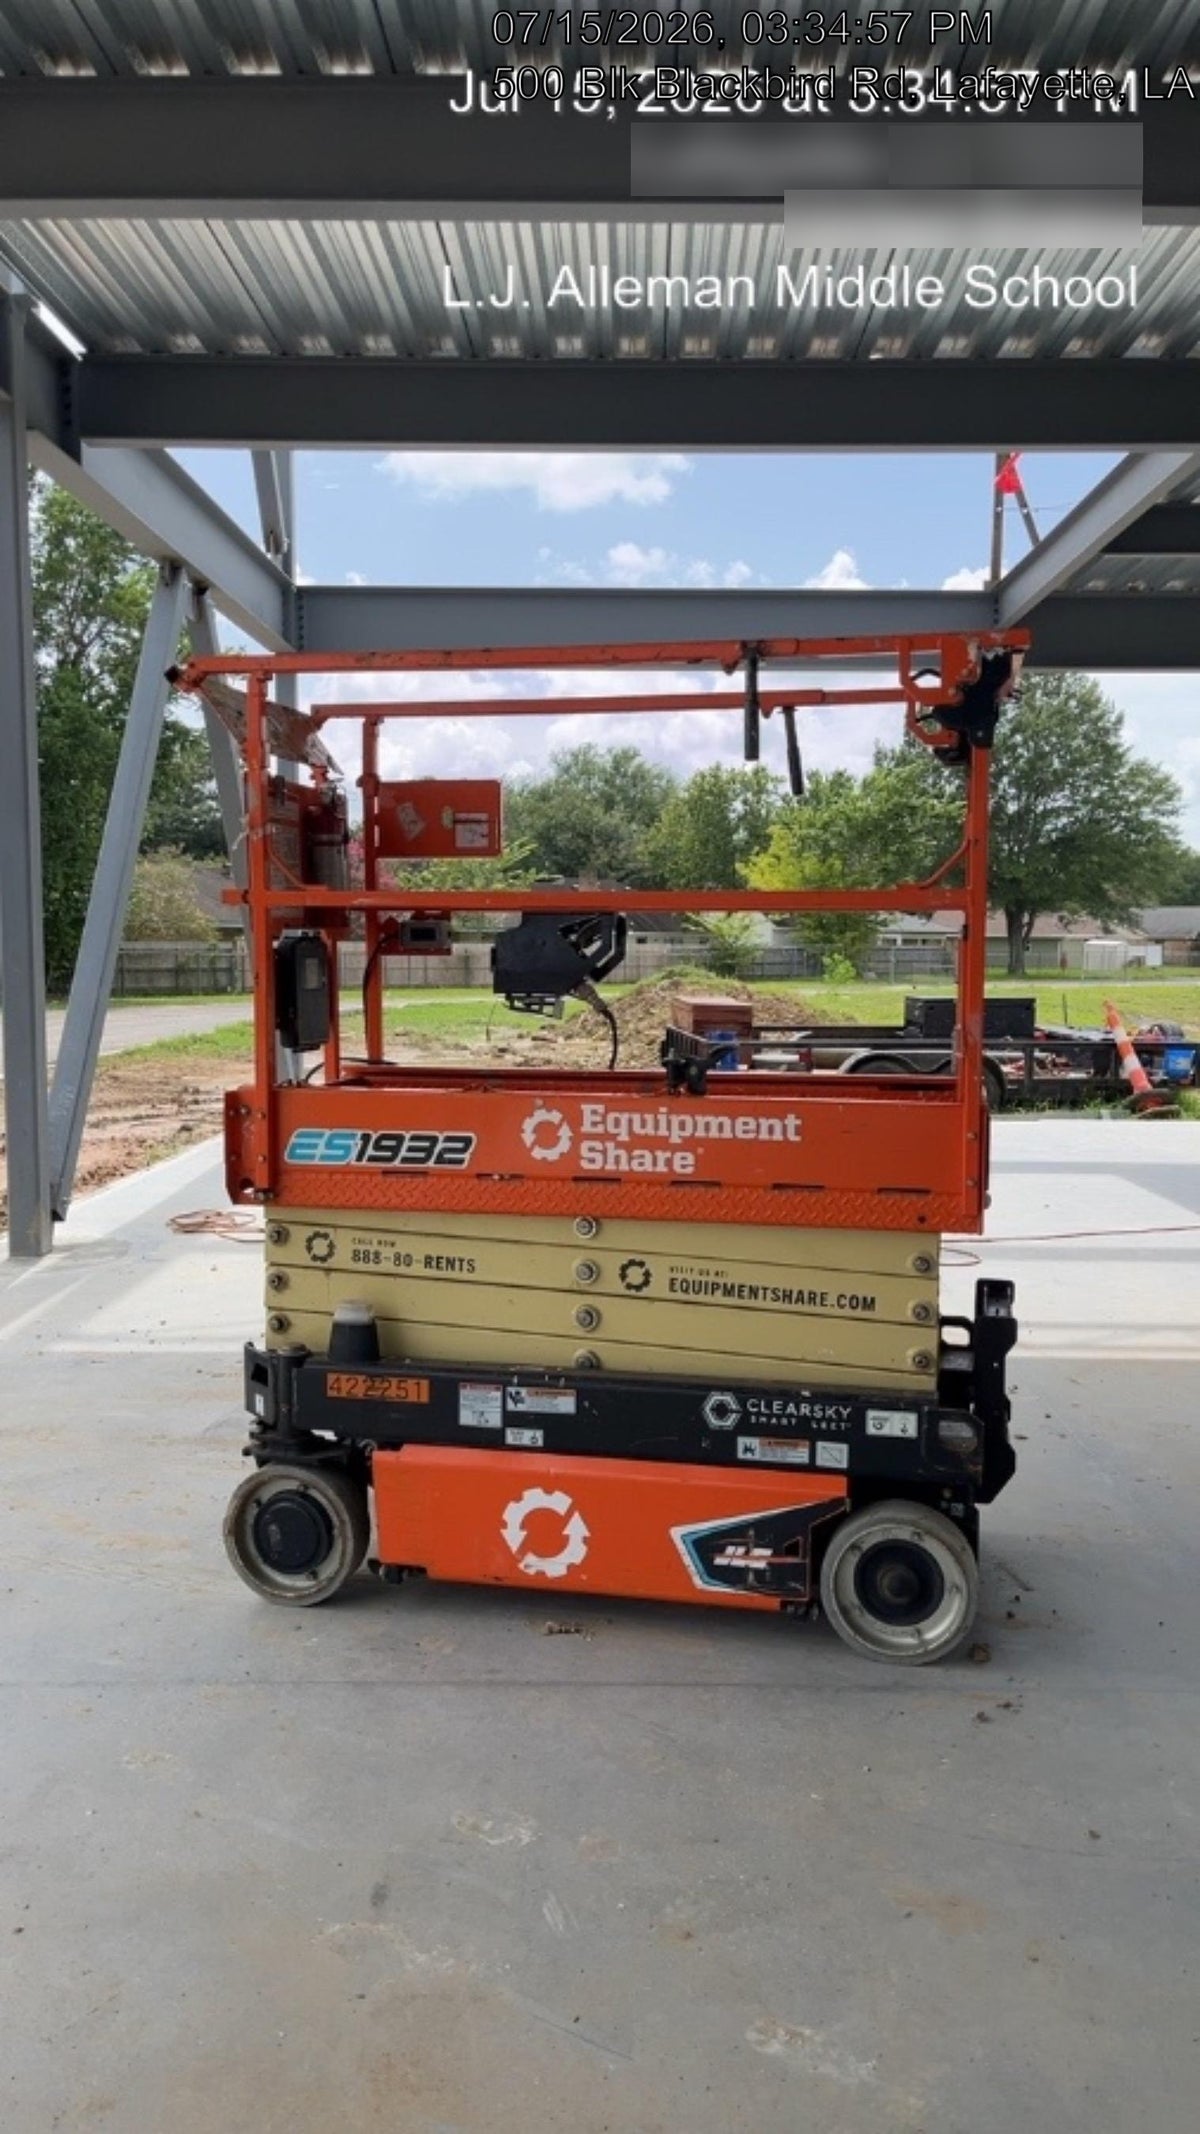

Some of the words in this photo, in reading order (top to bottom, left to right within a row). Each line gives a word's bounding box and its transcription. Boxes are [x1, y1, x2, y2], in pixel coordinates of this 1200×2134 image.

[581, 1104, 802, 1143] Equipment
[286, 1130, 475, 1167] ES1932
[580, 1140, 696, 1174] Share
[351, 1249, 476, 1273] 888-80-RENTS
[669, 1277, 876, 1312] EQUIPMENTSHARE.COM
[746, 1398, 852, 1420] CLEARSKY
